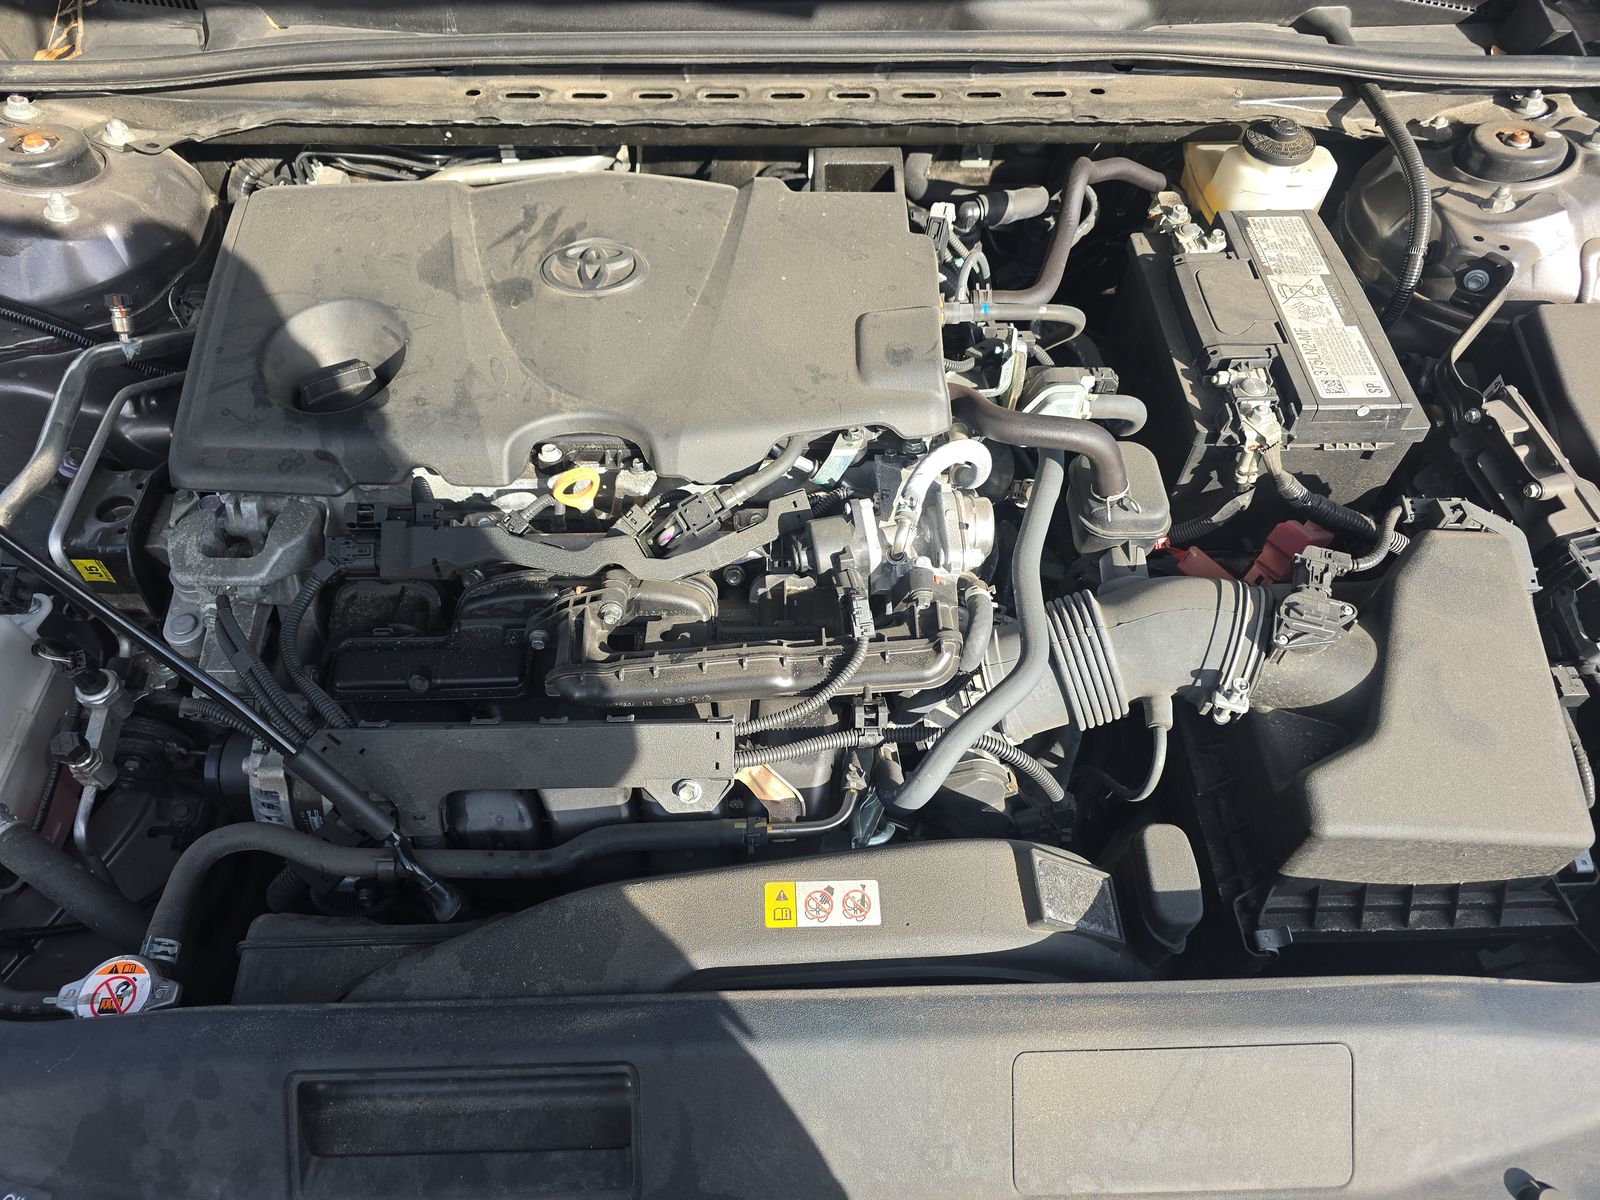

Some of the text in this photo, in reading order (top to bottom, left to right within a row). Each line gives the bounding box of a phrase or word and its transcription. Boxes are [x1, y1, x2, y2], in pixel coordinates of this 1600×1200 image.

[1316, 285, 1327, 296] Pb
[1293, 327, 1329, 376] 375LN2-MF
[1366, 382, 1383, 394] SP
[85, 565, 103, 578] J5
